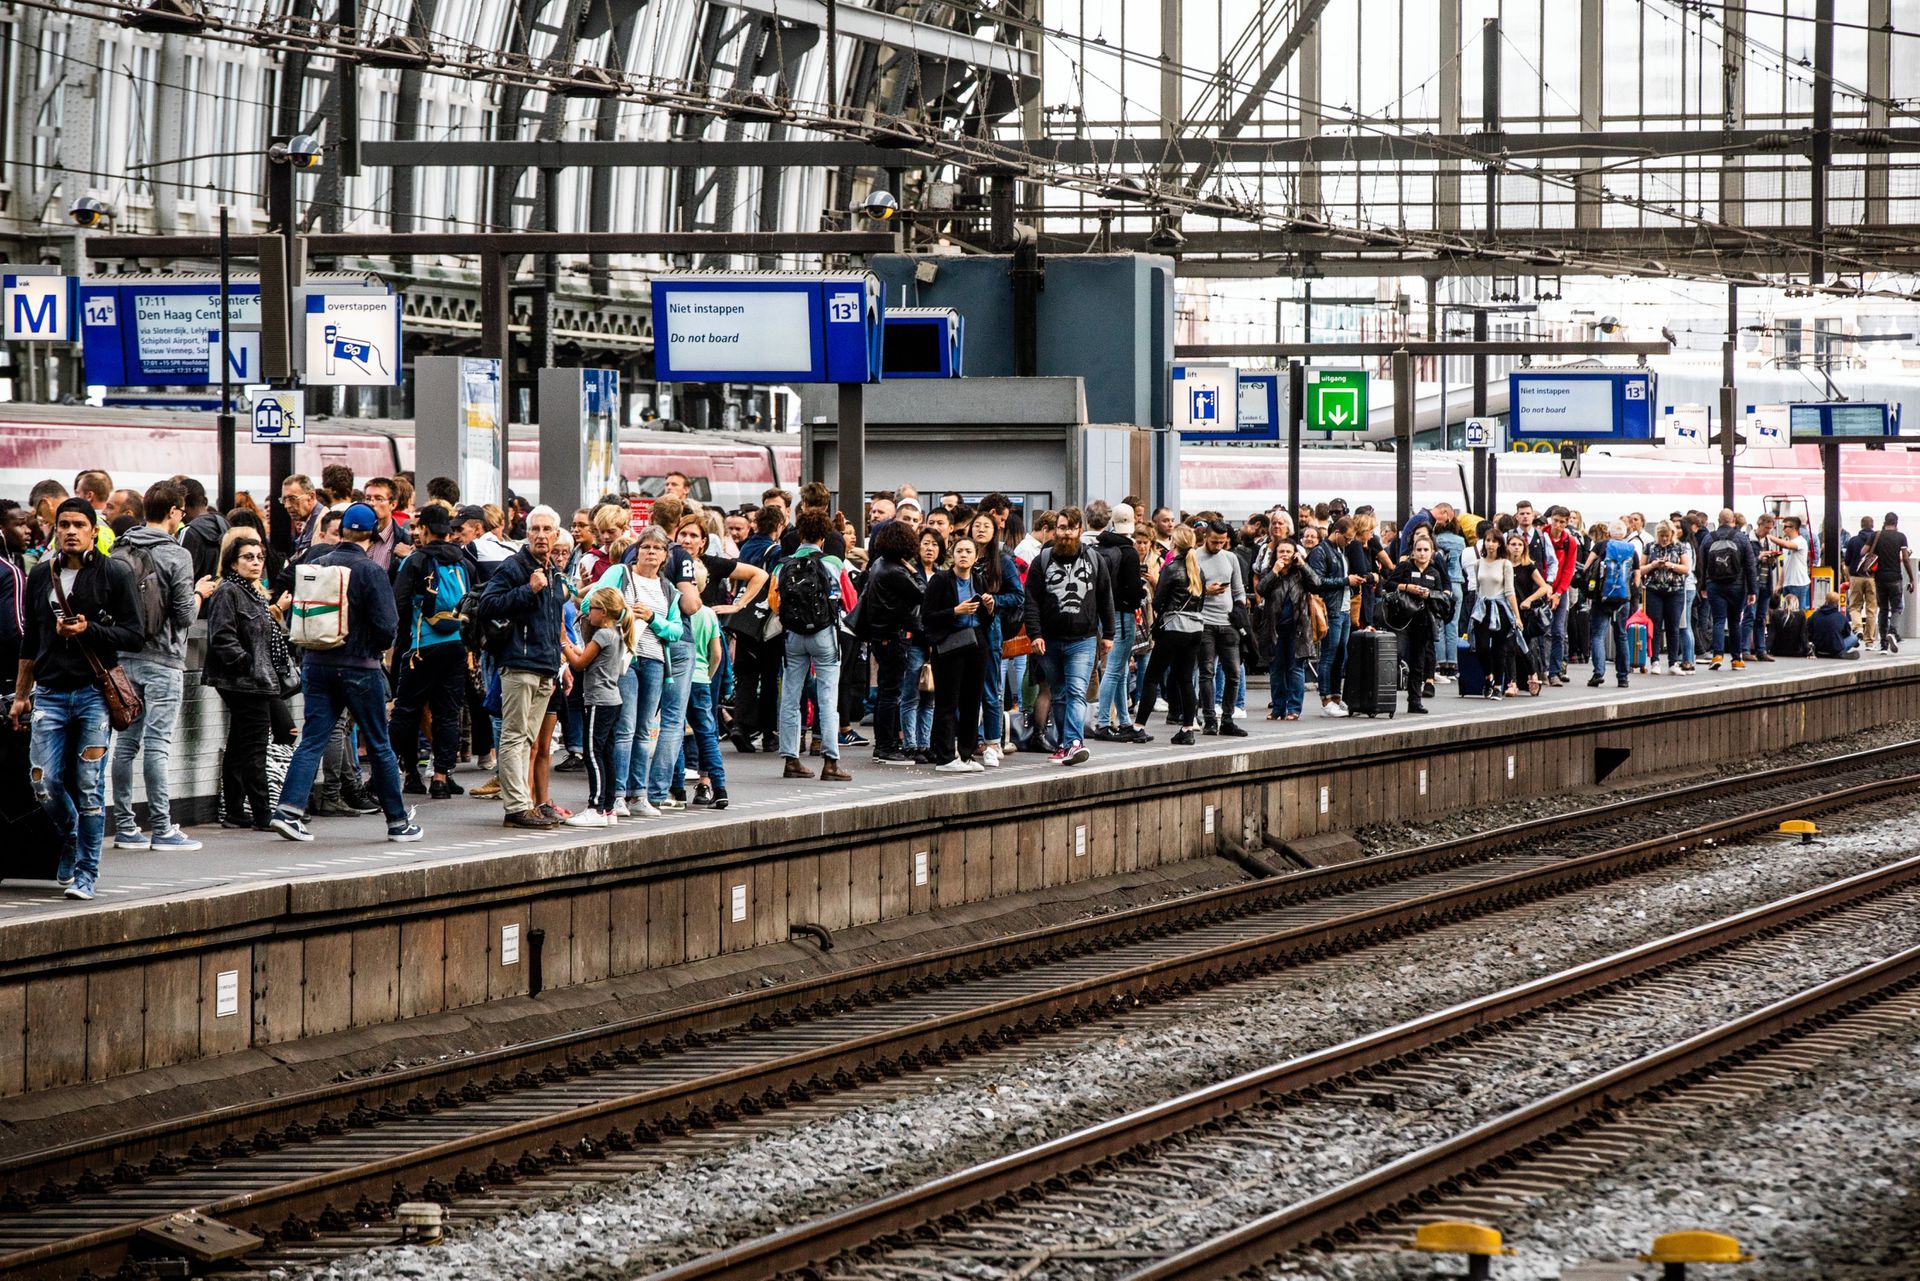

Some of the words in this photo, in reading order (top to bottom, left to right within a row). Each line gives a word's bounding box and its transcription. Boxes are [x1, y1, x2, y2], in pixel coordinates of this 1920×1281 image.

[139, 297, 166, 306] 17:11
[328, 303, 387, 312] overstappen
[669, 303, 691, 313] Niet
[694, 303, 744, 316] instappen
[14, 294, 56, 333] M
[139, 310, 160, 320] Den
[164, 309, 193, 322] Haag
[195, 309, 242, 320] Centaal
[141, 337, 171, 345] Schiphol
[670, 333, 685, 343] Do
[688, 334, 705, 343] not
[709, 333, 739, 343] board
[228, 347, 247, 378] N
[1321, 375, 1347, 383] uitgang
[1520, 387, 1535, 395] Niet
[1536, 387, 1570, 396] instappen
[1520, 406, 1530, 414] Do
[1545, 406, 1567, 414] board
[1562, 460, 1575, 477] V
